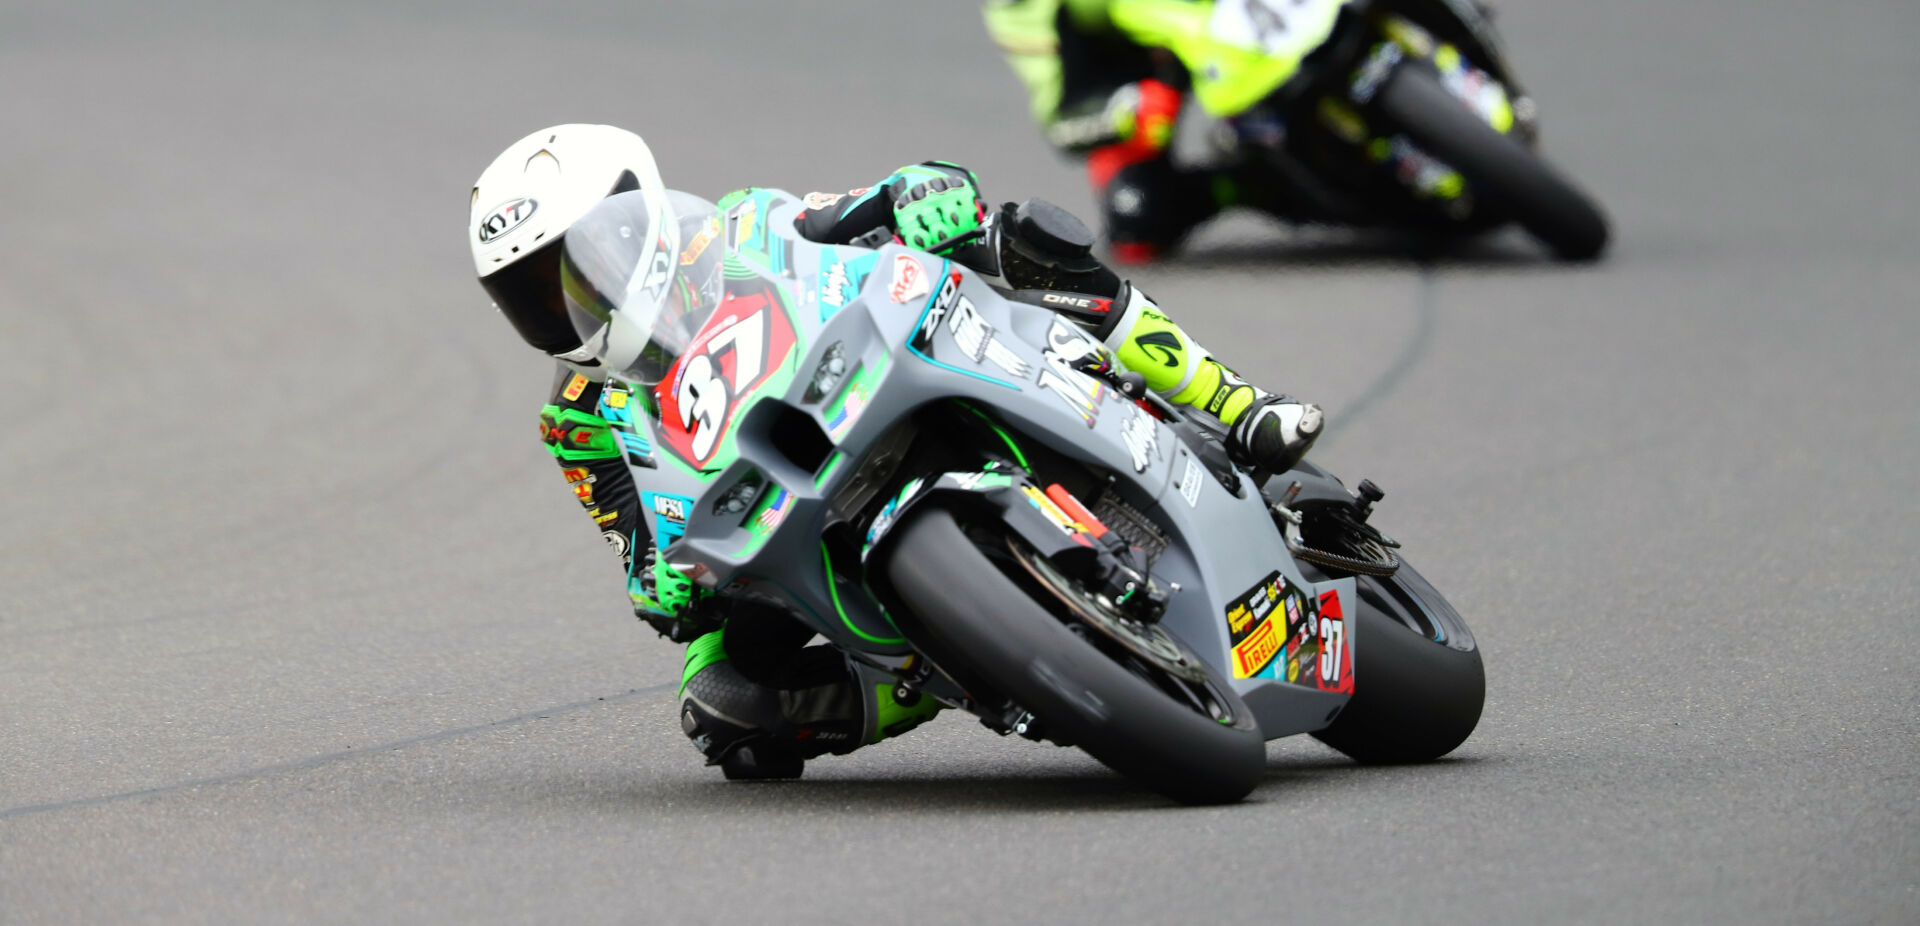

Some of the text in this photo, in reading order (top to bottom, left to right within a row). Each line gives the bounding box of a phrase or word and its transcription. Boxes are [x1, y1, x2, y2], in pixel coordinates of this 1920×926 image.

[481, 199, 528, 241] KYT
[677, 308, 765, 463] 37
[1237, 619, 1279, 675] PIRELLI
[1320, 617, 1343, 682] 37
